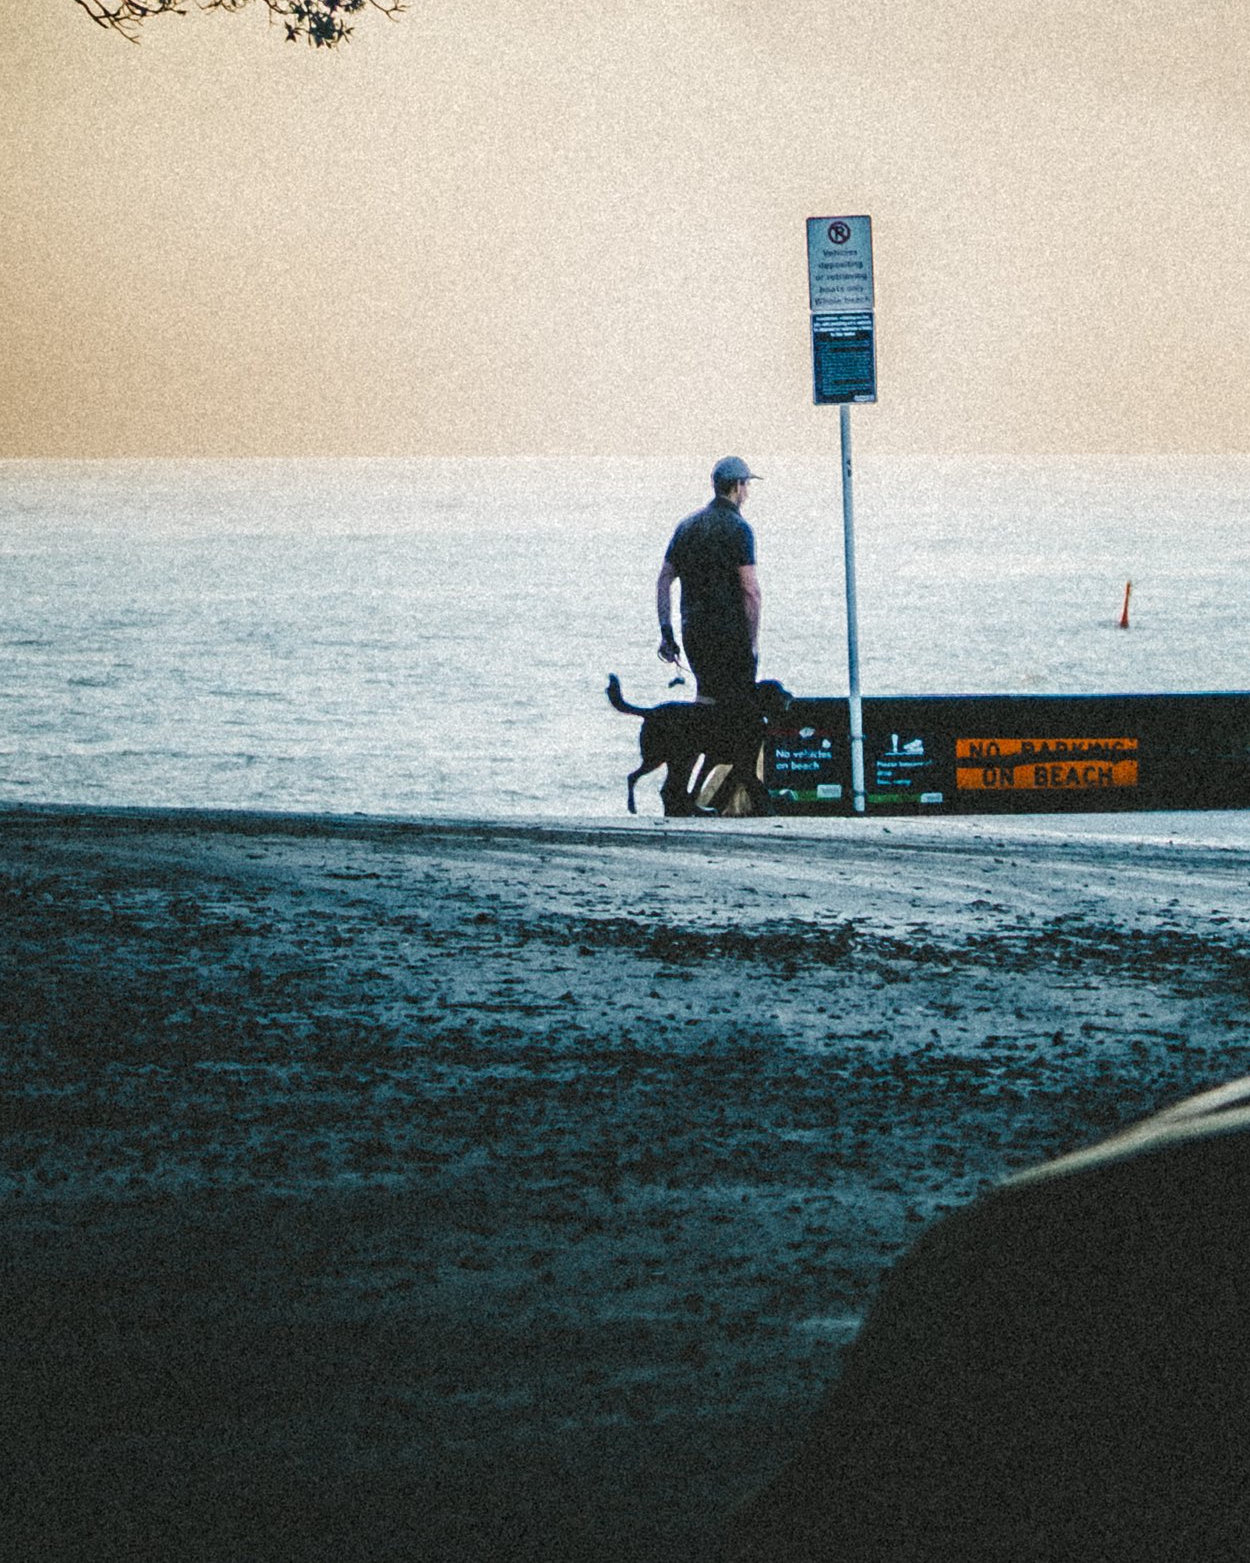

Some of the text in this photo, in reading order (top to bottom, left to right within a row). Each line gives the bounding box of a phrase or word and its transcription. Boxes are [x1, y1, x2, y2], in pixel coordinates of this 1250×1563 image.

[775, 749, 832, 759] No vehicles
[969, 741, 1000, 758] NO
[775, 761, 820, 771] on beach
[982, 765, 1113, 786] ON BEACH
